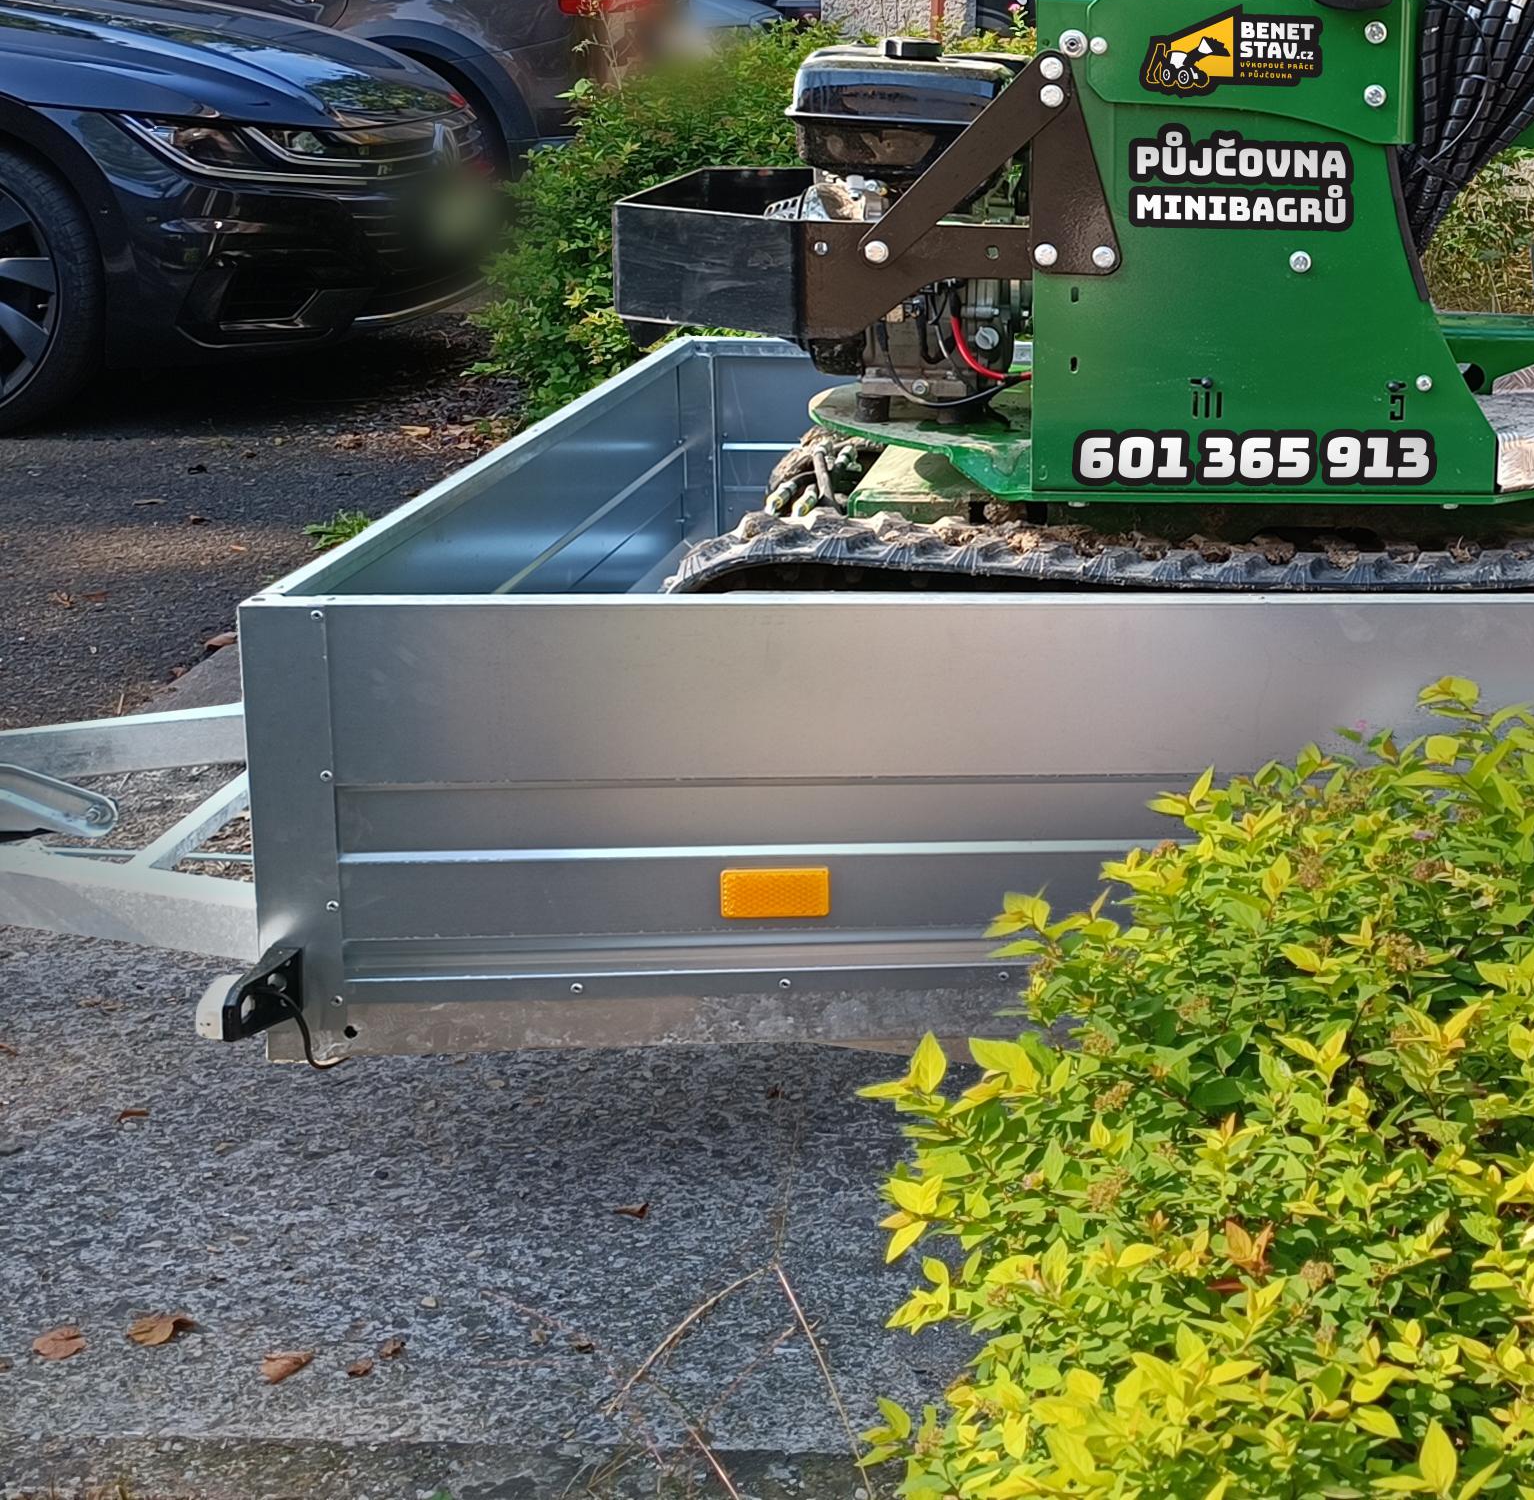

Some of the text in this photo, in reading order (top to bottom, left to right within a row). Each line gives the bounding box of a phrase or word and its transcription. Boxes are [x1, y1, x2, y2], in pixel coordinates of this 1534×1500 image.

[1240, 21, 1314, 40] BENET
[1239, 61, 1315, 70] VÝKOPOVÉ PRÁCE
[1248, 70, 1292, 79] PŮJČOVNA
[1136, 131, 1346, 179] PŮJČOVNA
[1136, 184, 1348, 224] MINIBAGRŮ
[1079, 437, 1430, 479] 601 365 913
